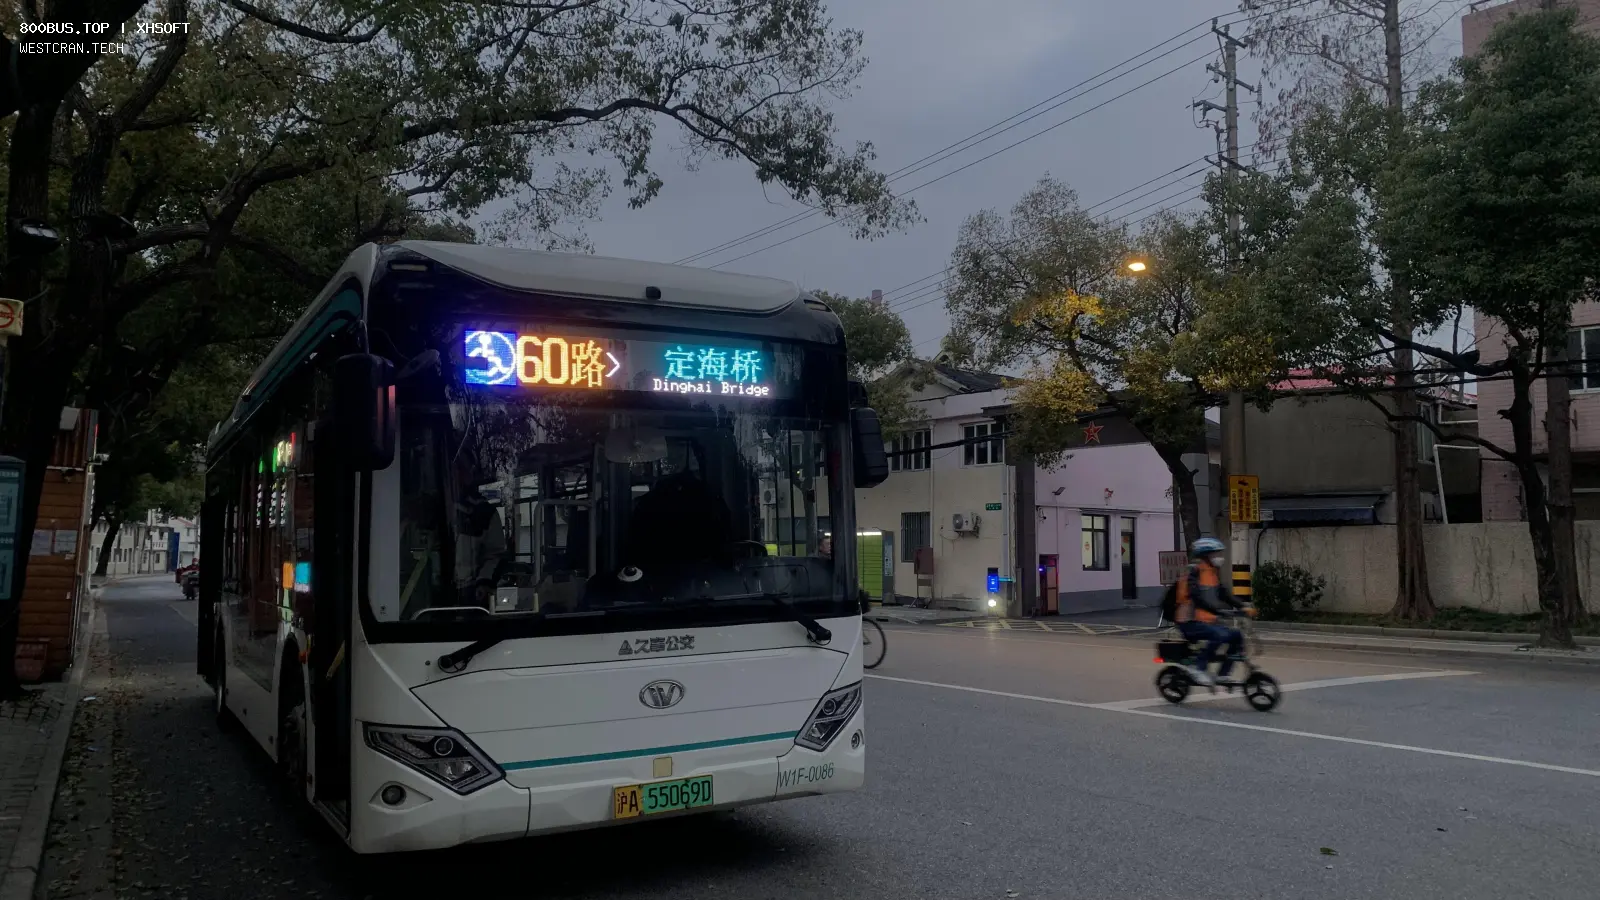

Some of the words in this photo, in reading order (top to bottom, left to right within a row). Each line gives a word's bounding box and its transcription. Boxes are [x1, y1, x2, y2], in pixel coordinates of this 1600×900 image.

[516, 335, 606, 388] 60路
[664, 345, 763, 384] 定海桥
[653, 378, 712, 394] Dinghai
[721, 381, 770, 397] Bridge
[634, 634, 695, 654] 久事公交
[779, 762, 834, 788] W1F-0086
